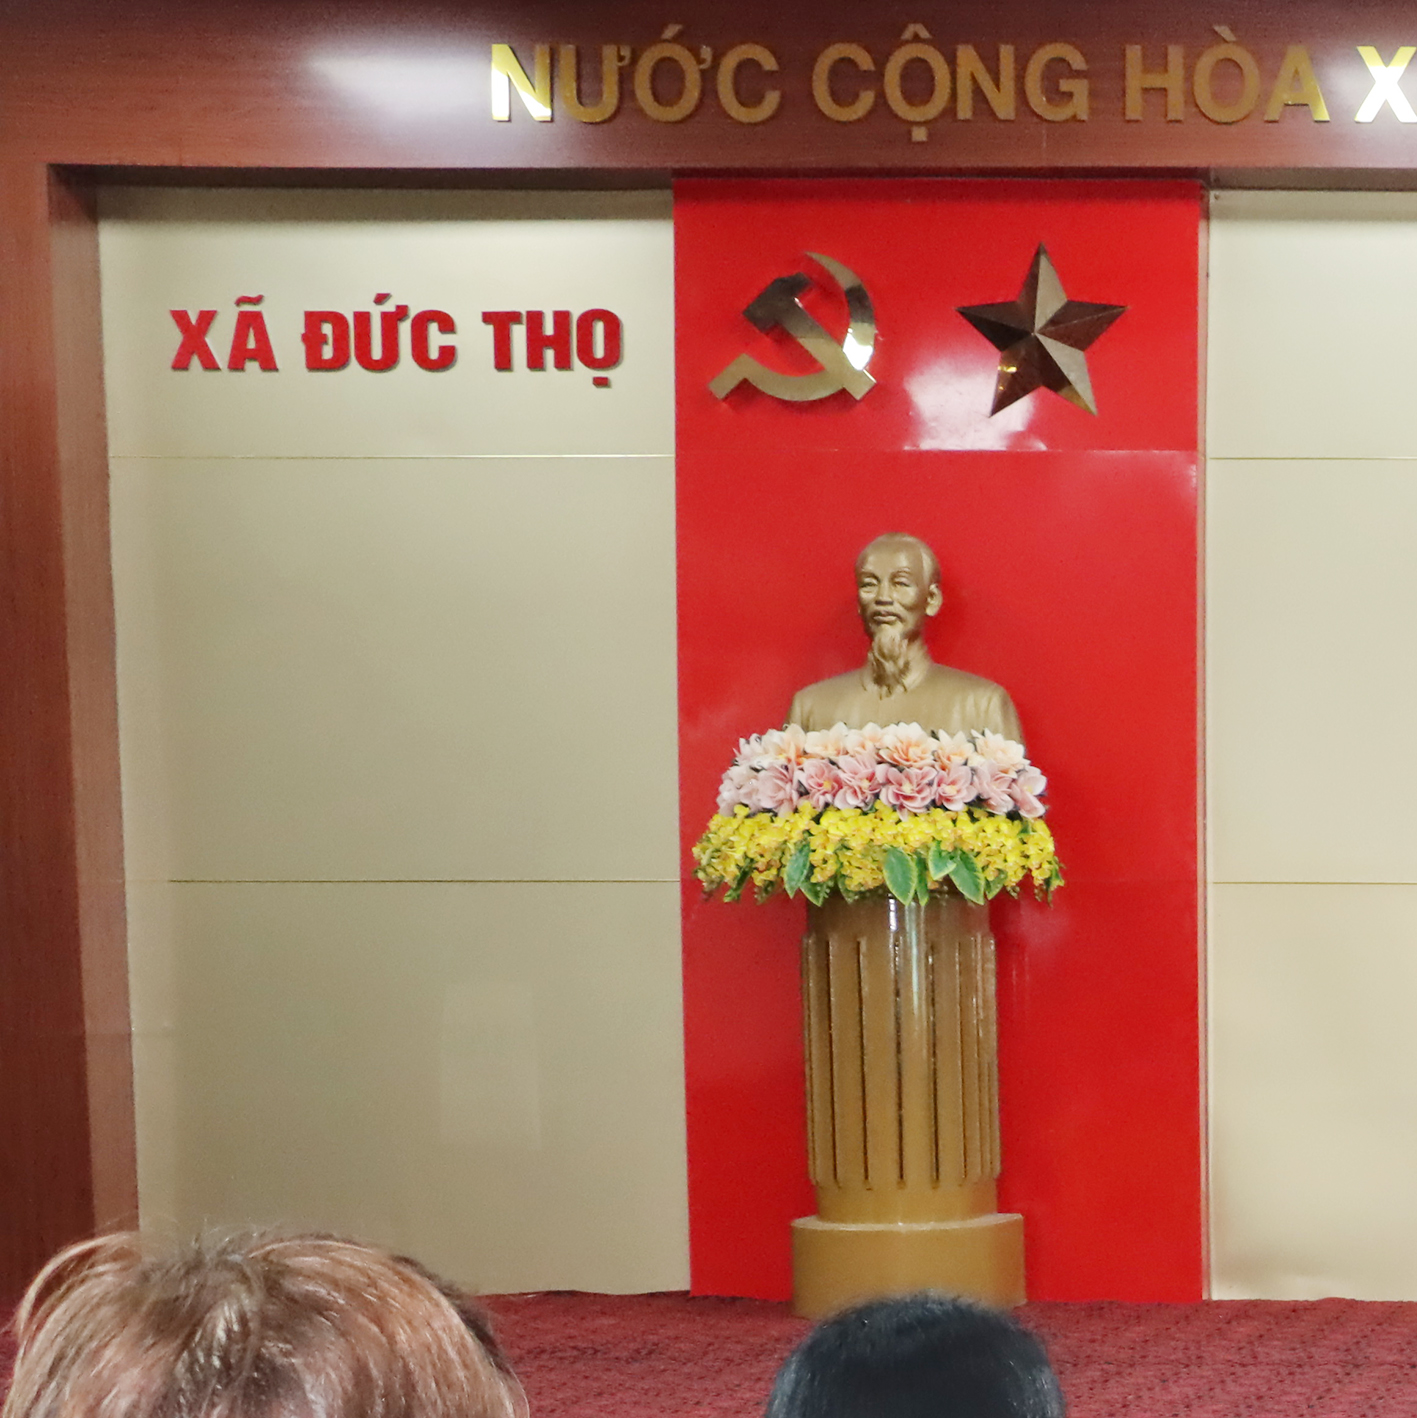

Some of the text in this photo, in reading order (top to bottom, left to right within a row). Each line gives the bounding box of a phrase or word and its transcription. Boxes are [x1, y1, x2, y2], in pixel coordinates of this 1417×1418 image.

[491, 24, 781, 122] NƯỚC
[812, 23, 1090, 142] CỘNG
[1124, 25, 1330, 123] HÒA
[169, 292, 623, 388] XÃ ĐỨC THỌ
